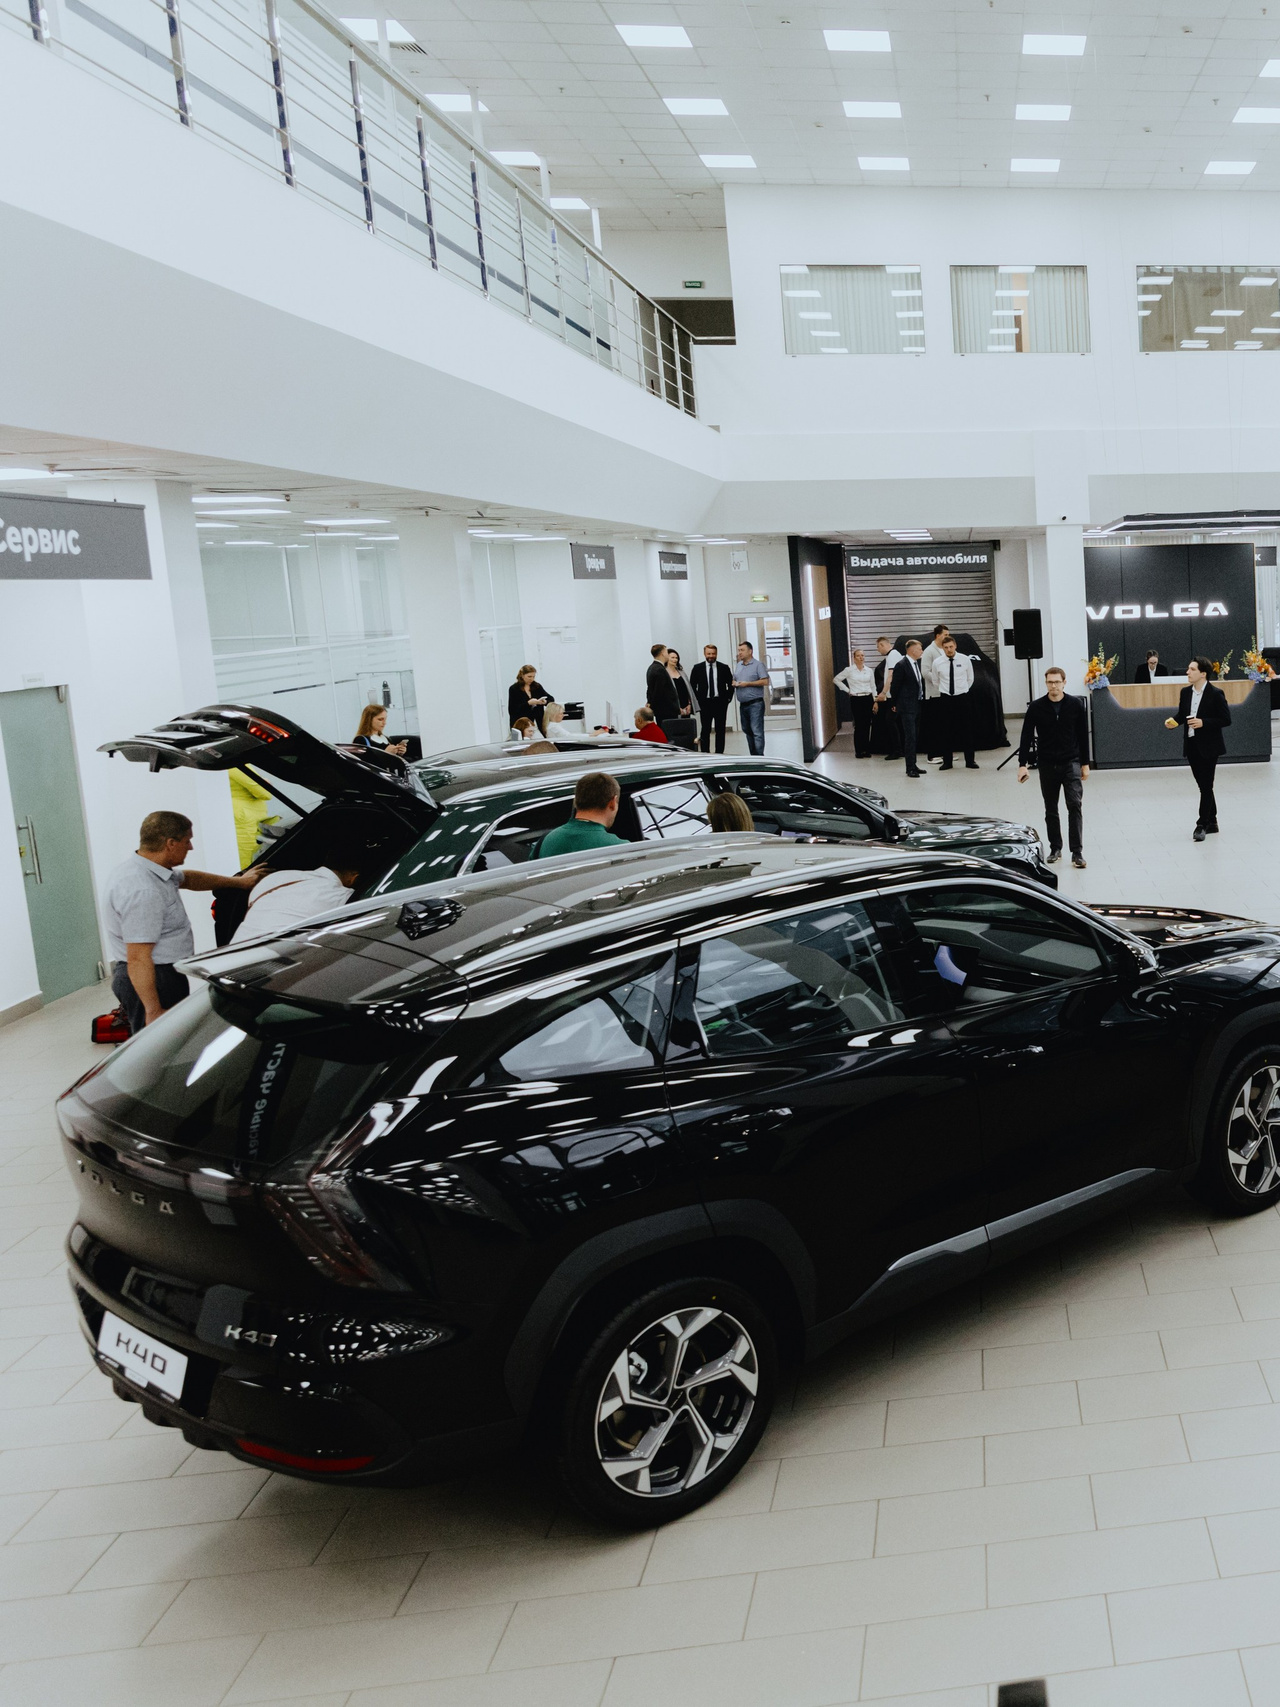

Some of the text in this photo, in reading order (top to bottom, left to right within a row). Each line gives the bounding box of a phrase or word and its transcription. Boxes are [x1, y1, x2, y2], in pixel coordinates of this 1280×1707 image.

[850, 553, 988, 569] Выдача автомобиля
[1085, 602, 1229, 620] VOLGA
[224, 1324, 278, 1348] K40
[115, 1331, 168, 1376] K40
